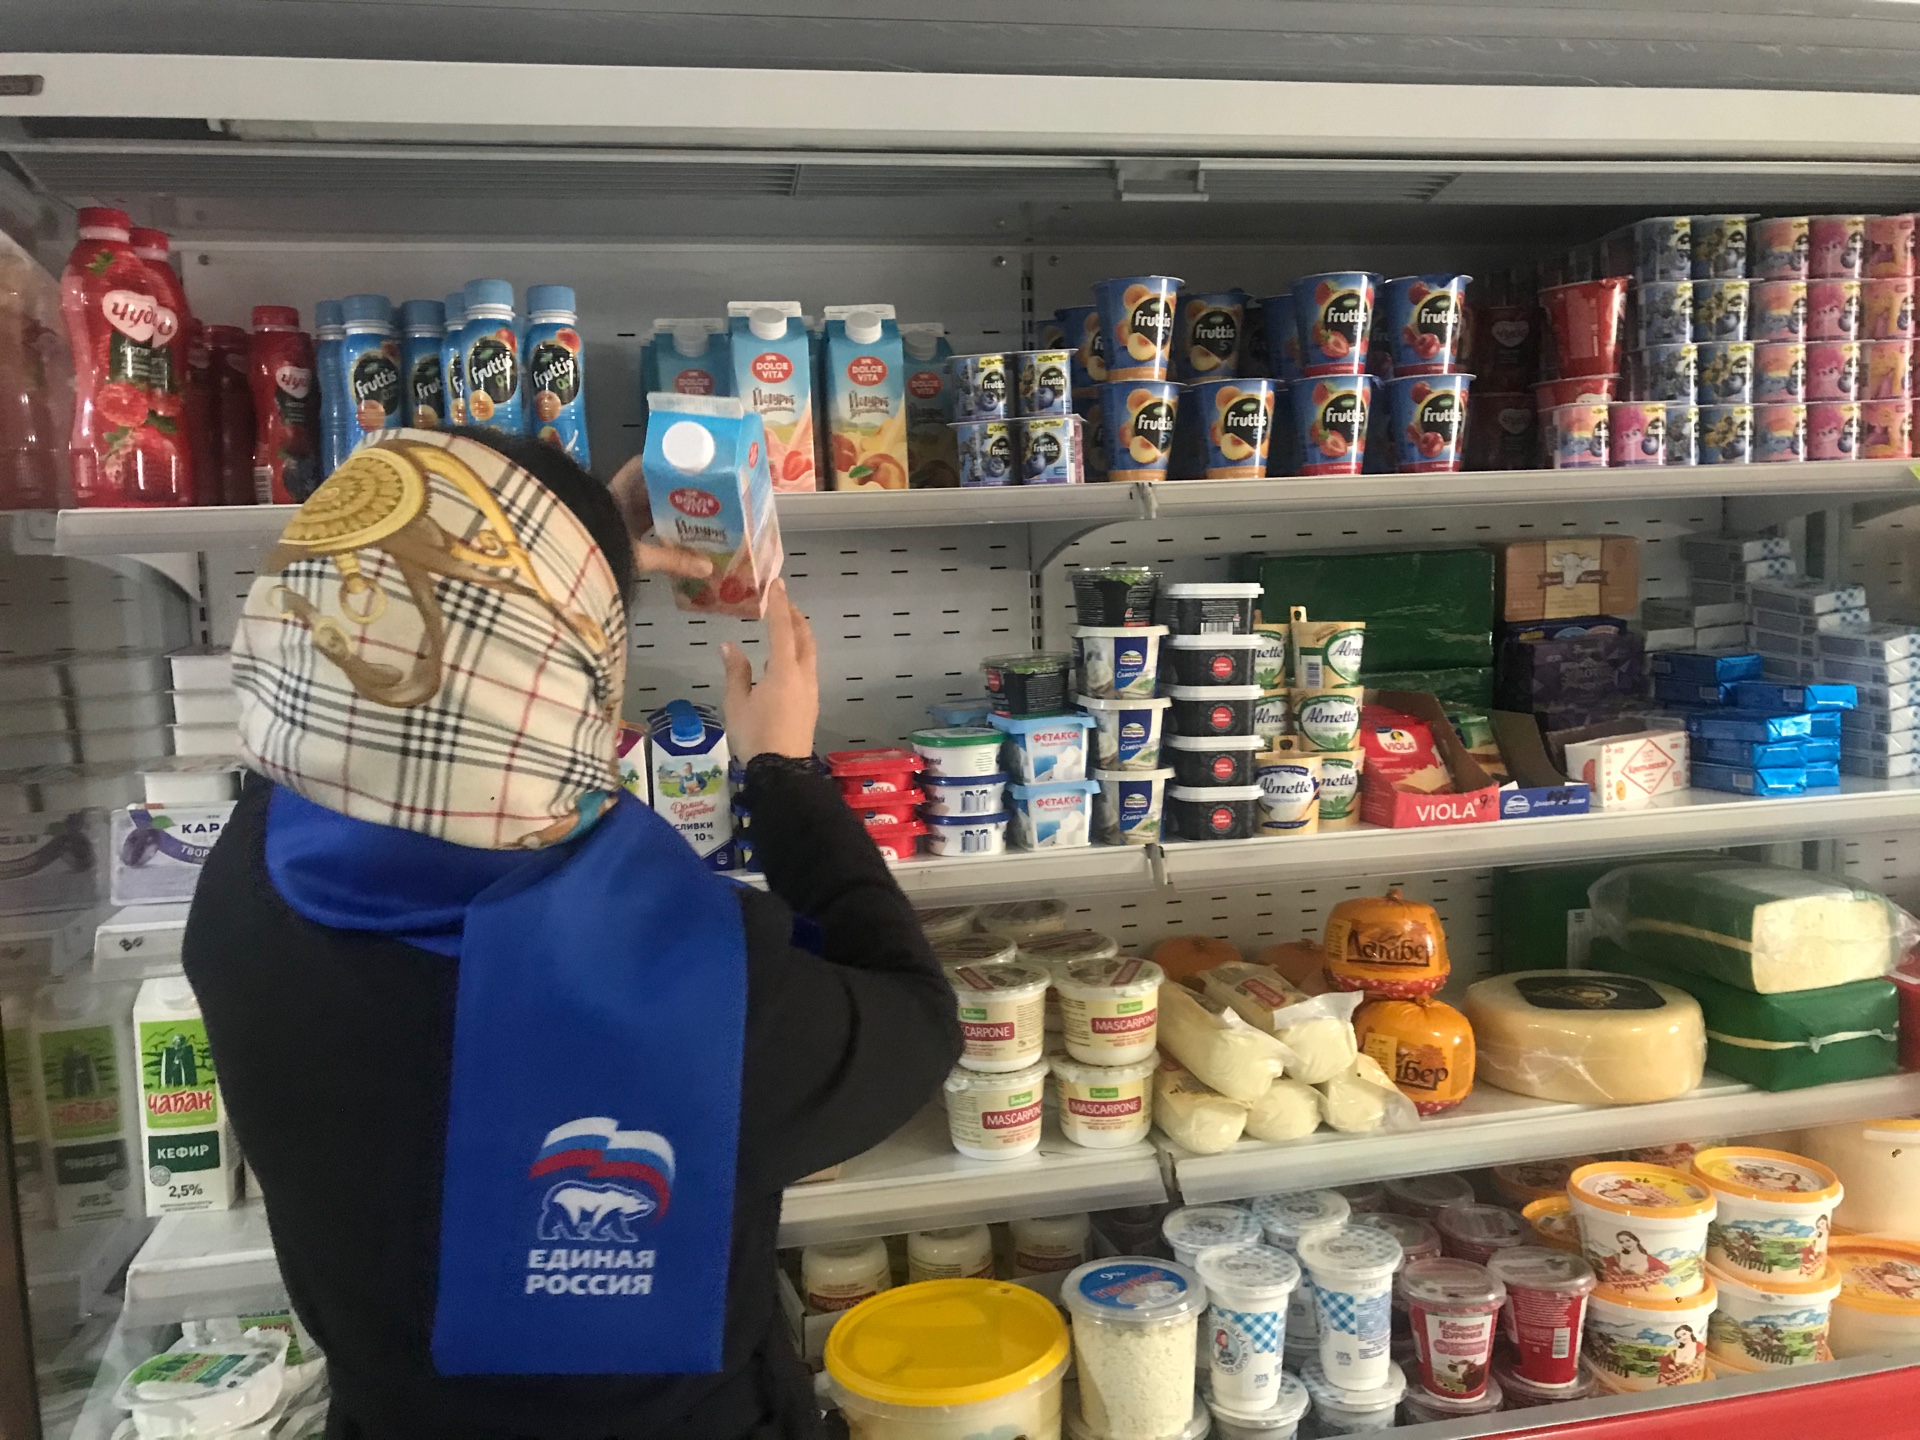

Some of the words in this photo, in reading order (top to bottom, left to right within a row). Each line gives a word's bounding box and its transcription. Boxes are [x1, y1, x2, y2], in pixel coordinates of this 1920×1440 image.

[1135, 310, 1171, 328] frutis
[1327, 306, 1367, 323] frutts
[1420, 307, 1458, 324] fruts
[1195, 323, 1235, 340] fruttis
[756, 362, 788, 371] DOLCE
[852, 365, 883, 374] DOLCE
[678, 378, 710, 386] DOLCE
[762, 371, 784, 379] VITA
[857, 373, 879, 382] VITA
[1227, 410, 1268, 428] frutts
[1325, 407, 1364, 423] frutts
[1423, 407, 1462, 423] frutts
[1305, 707, 1357, 724] Almette
[1383, 742, 1415, 751] VIOLA
[1260, 777, 1311, 795] Almette
[1415, 801, 1477, 822] VIOLA
[182, 823, 220, 834] КАР
[674, 822, 714, 831] СЛИВКИ
[694, 832, 706, 842] 10
[181, 845, 211, 858] ТВОР
[962, 1025, 1011, 1039] CARPONE
[986, 1105, 1042, 1126] MASCARPON
[1071, 1100, 1138, 1116] MASCARPONE
[157, 1144, 210, 1159] КЕФИР
[168, 1183, 204, 1199] 2,5%
[527, 1249, 656, 1271] ЕДИНАЯ
[525, 1274, 653, 1295] РОССИЯ
